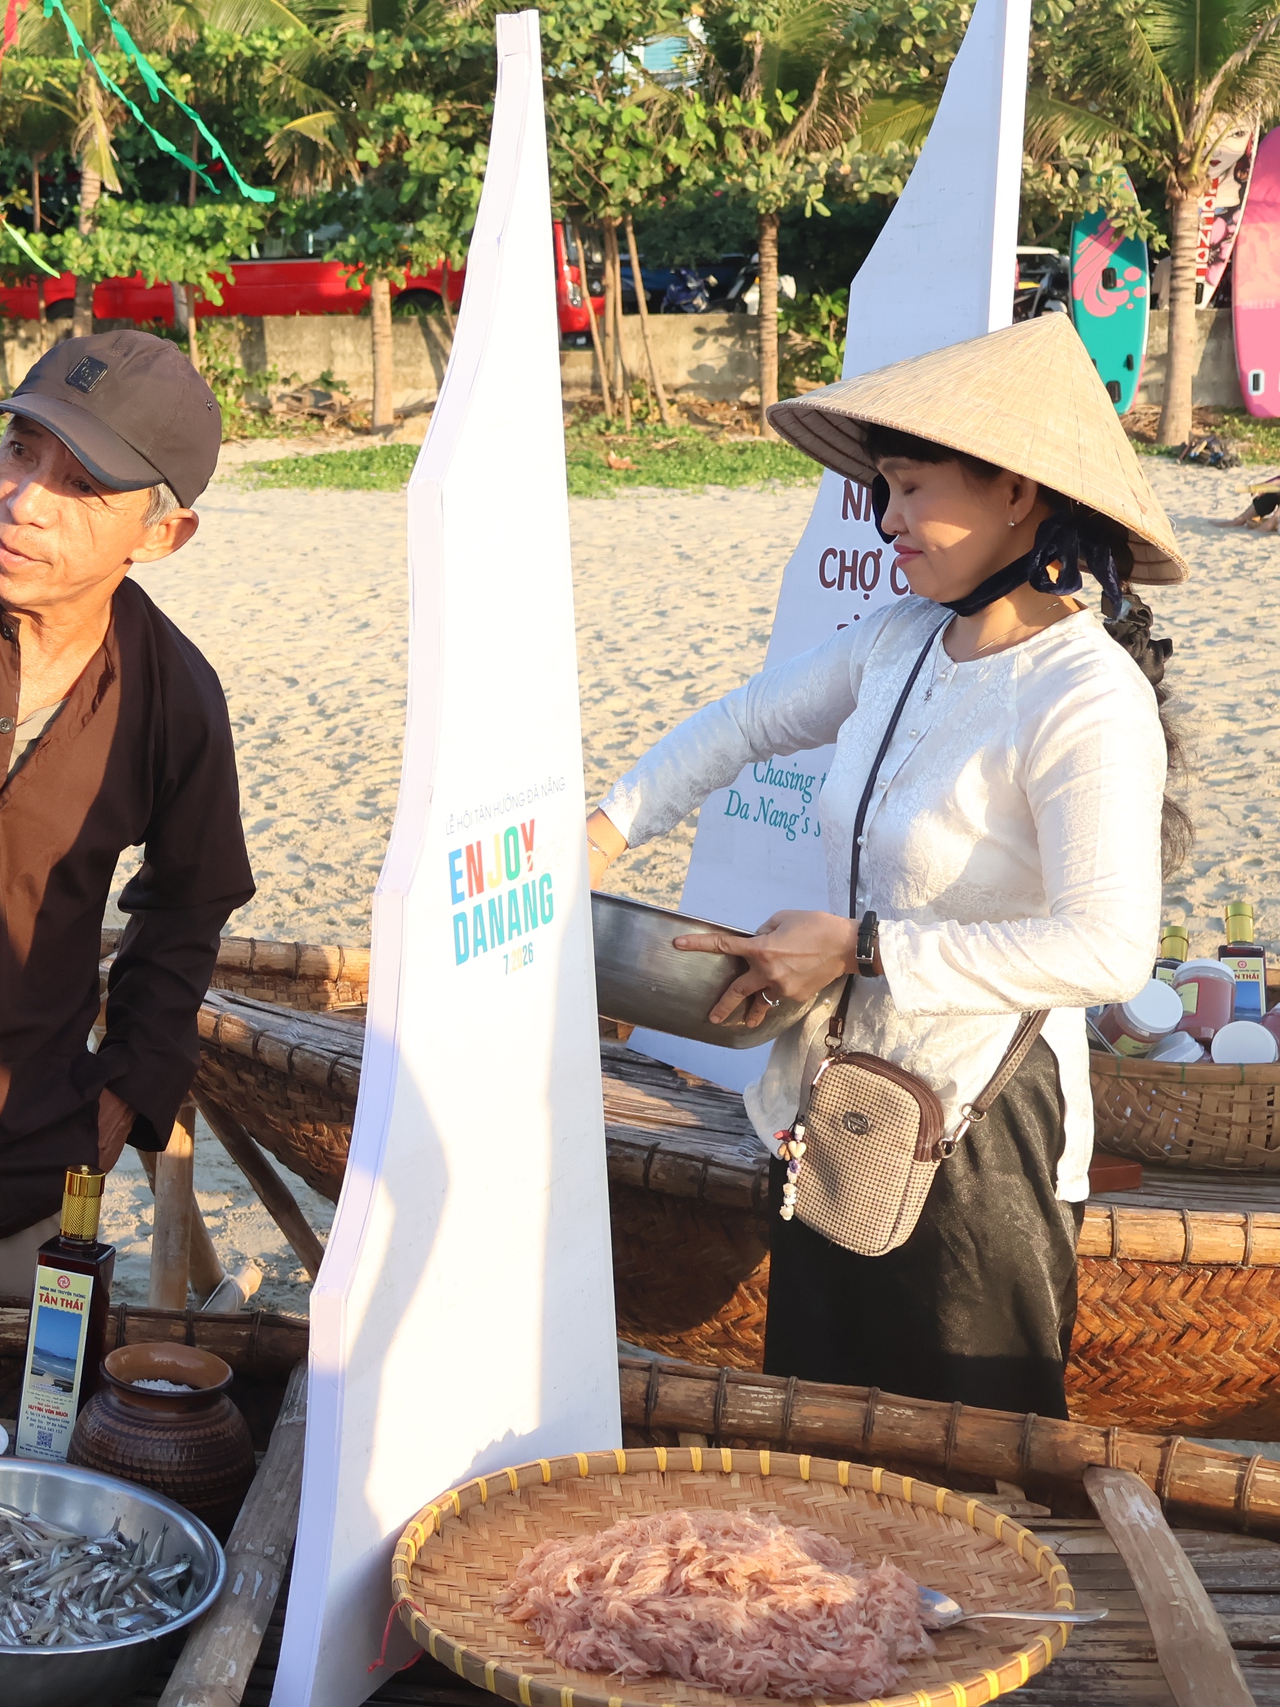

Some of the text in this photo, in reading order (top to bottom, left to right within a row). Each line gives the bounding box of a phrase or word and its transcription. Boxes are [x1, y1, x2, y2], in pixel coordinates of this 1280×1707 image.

[819, 547, 916, 600] CHỢ C
[724, 789, 750, 820] Da
[753, 757, 816, 804] Chasing
[445, 813, 455, 836] LỄ
[456, 810, 473, 831] HỘI
[474, 804, 492, 826] TẬN
[527, 784, 540, 804] ĐÀ
[448, 818, 536, 906] ENJOY
[452, 872, 554, 966] DANANG
[503, 942, 534, 976] 7.2026
[39, 1292, 84, 1311] TÂN THÁI
